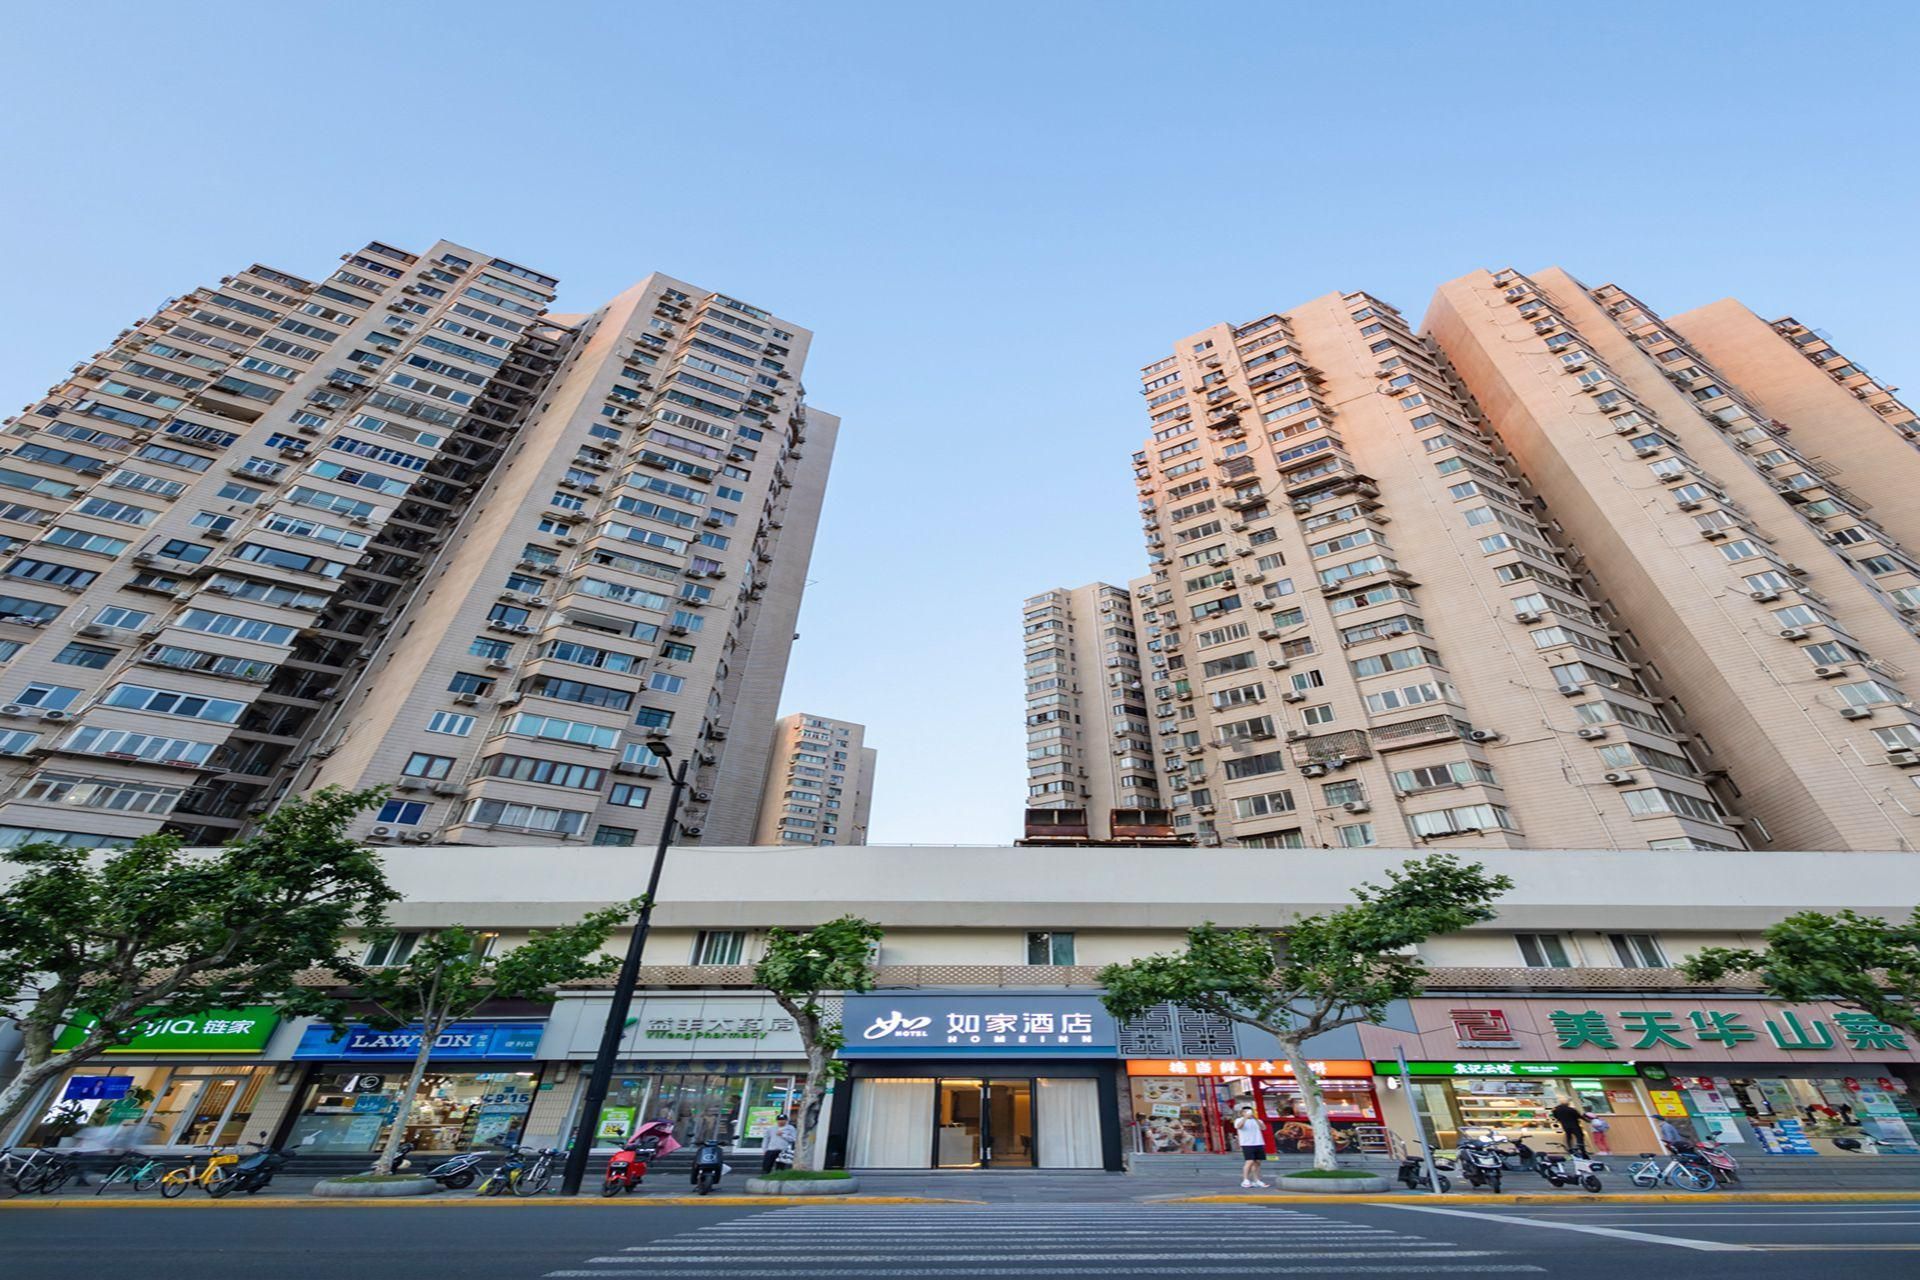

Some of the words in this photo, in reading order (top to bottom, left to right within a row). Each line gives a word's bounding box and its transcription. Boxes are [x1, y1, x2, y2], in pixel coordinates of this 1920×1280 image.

[202, 1019, 256, 1035] 链家
[649, 1018, 794, 1032] 益丰大药房
[946, 1012, 1093, 1034] 如家酒店
[694, 1031, 769, 1040] Pharmacy
[1453, 1063, 1516, 1075] 袁记云饺
